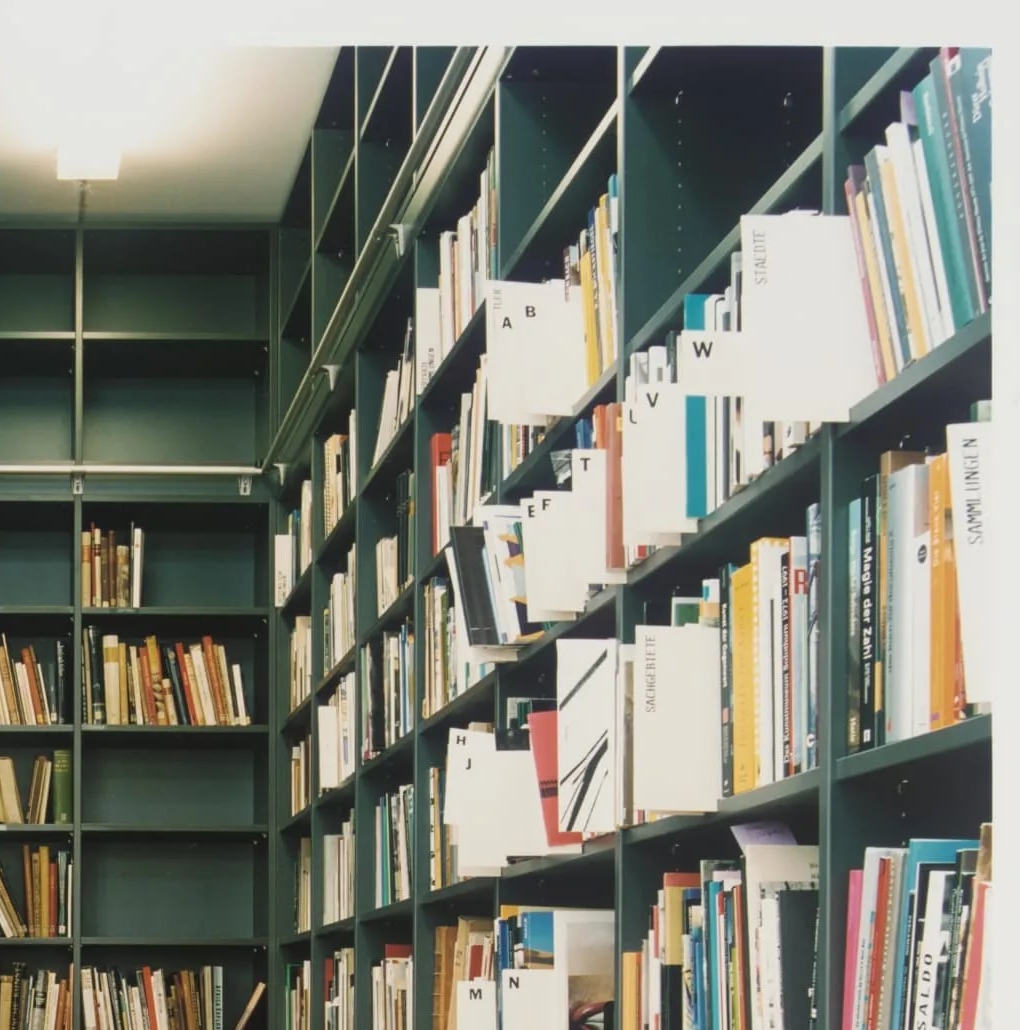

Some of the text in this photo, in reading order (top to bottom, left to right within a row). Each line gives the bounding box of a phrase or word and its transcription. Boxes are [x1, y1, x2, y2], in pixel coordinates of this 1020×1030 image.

[752, 230, 768, 286] STAEDTE
[525, 305, 536, 318] B
[501, 316, 513, 329] A
[692, 341, 713, 358] W
[646, 392, 659, 408] V
[580, 457, 591, 471] T
[962, 437, 984, 546] SAMMLUNGEN
[542, 498, 551, 511] F
[527, 505, 535, 518] E
[861, 546, 872, 660] Magie der Zahl
[645, 635, 657, 713] SACHGEBIETE
[456, 735, 466, 746] H
[465, 757, 472, 770] J
[508, 976, 520, 989] N
[469, 988, 483, 1000] M
